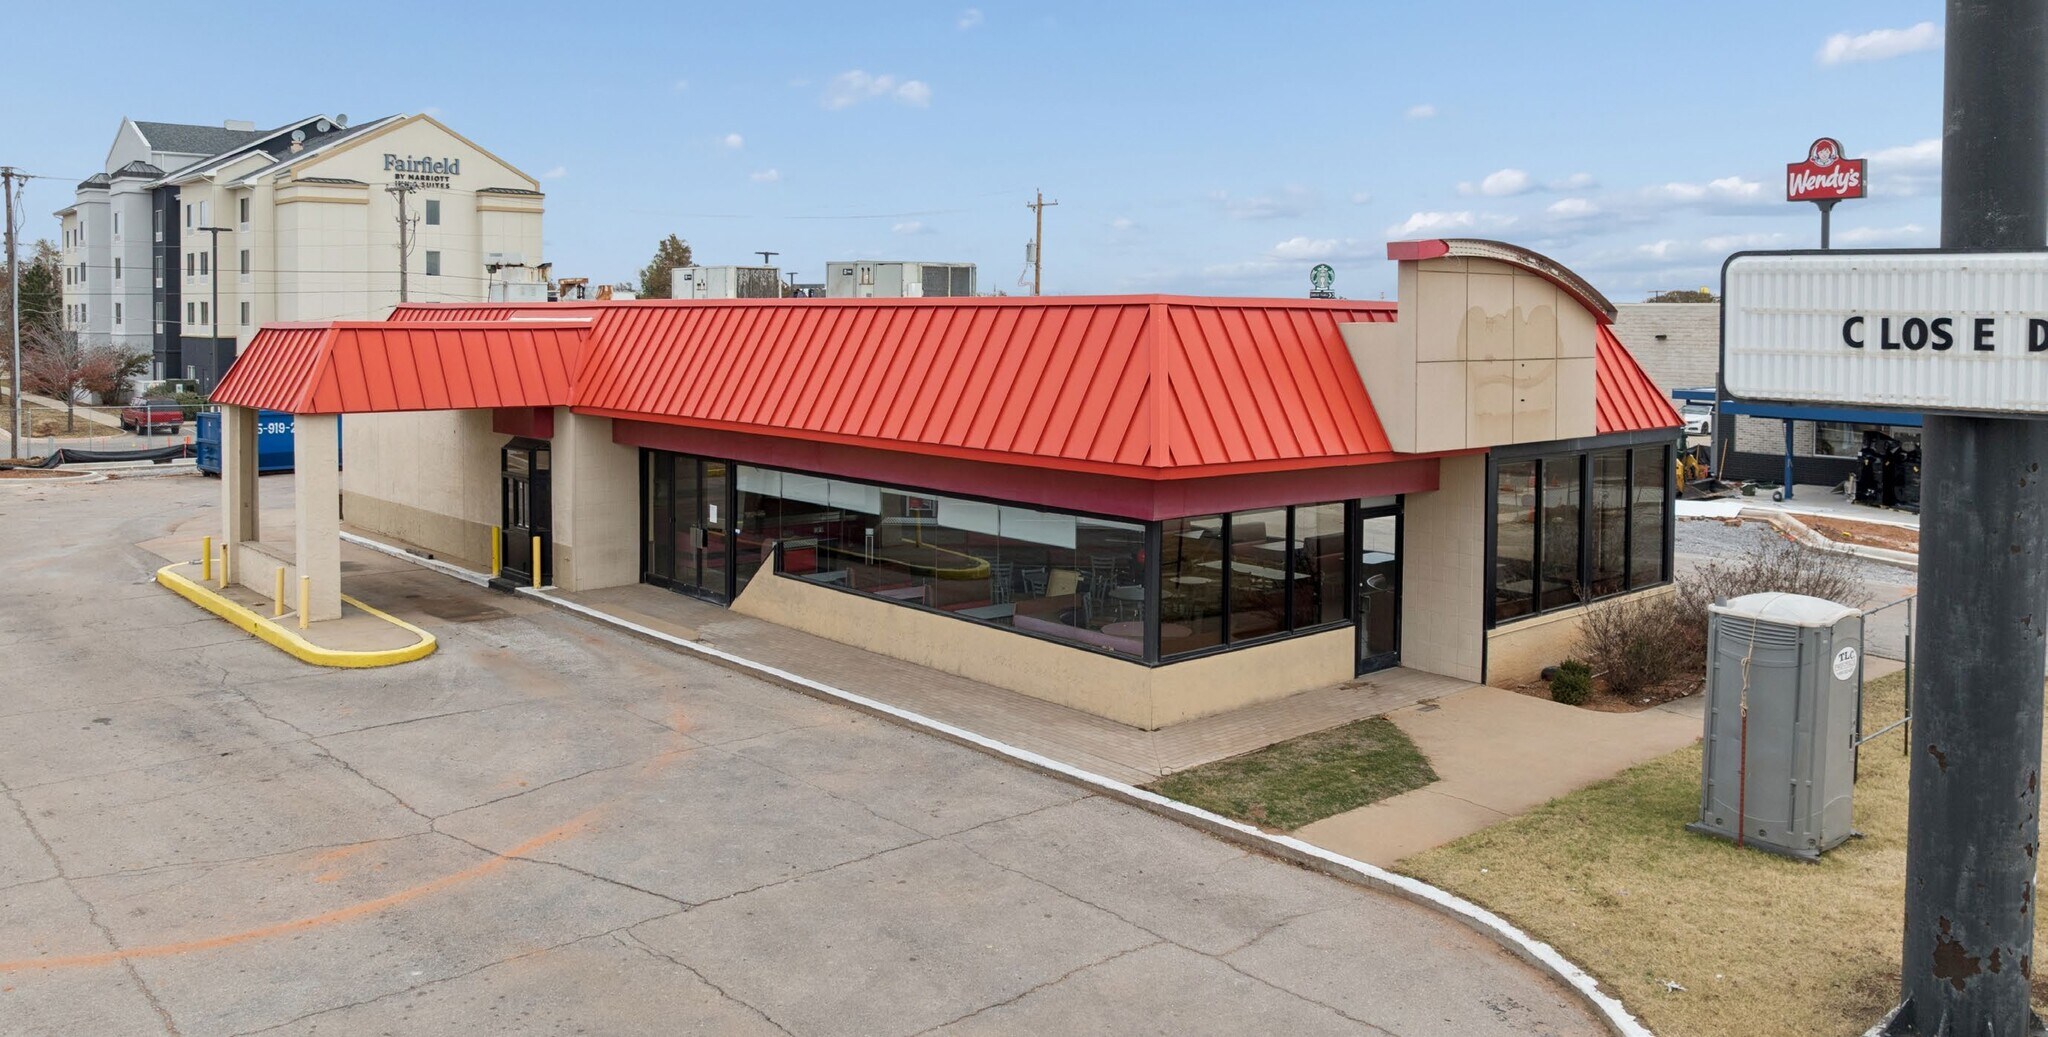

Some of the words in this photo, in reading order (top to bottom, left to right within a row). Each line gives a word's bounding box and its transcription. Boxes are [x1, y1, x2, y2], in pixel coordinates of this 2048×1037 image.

[383, 154, 460, 175] Fairfield
[408, 174, 450, 182] MARRIOTT
[1789, 165, 1859, 196] Wendy's
